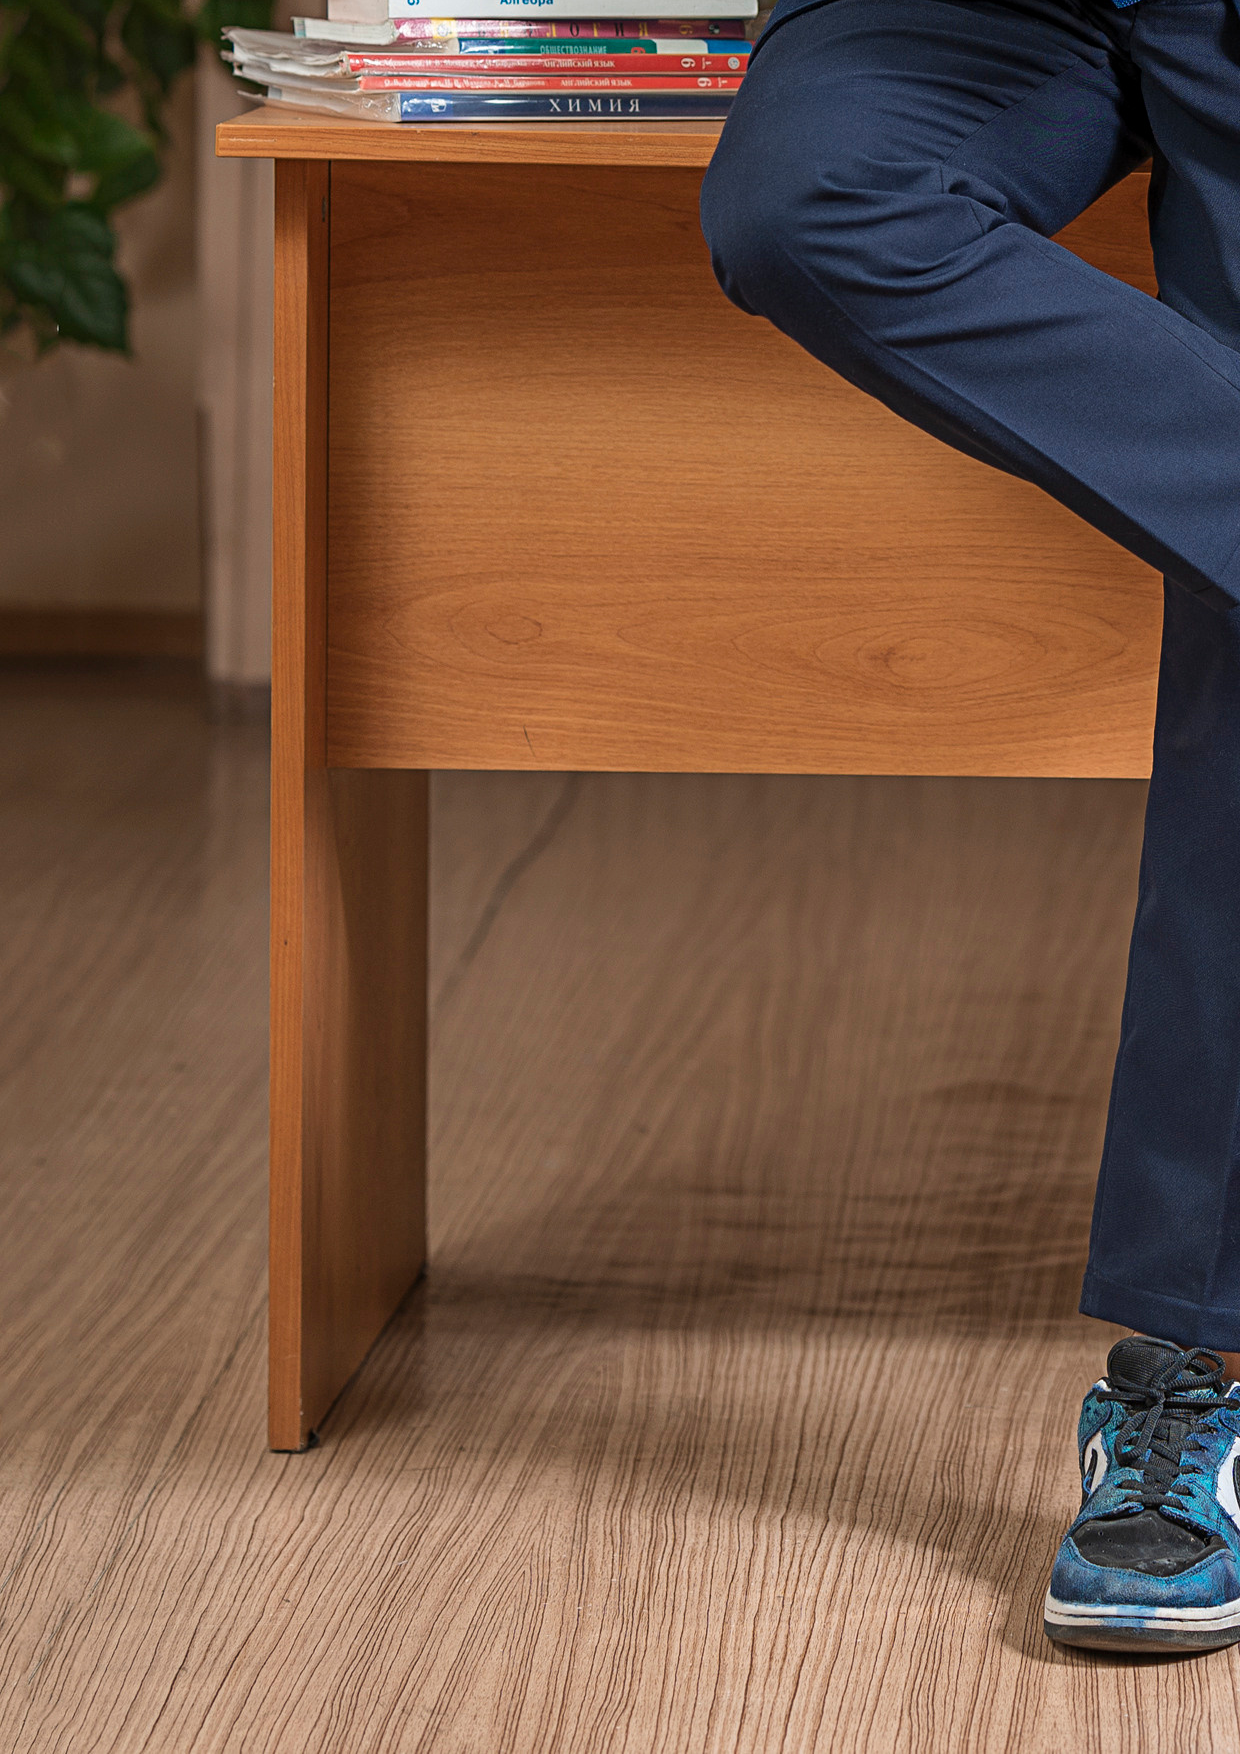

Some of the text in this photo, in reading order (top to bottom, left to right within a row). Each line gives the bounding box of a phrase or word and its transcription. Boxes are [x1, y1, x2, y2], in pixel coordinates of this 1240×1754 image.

[593, 59, 615, 68] ЯЗЫК
[560, 78, 610, 87] АНГЛИЙСКИЙ
[611, 79, 633, 87] ЯЗЫК
[549, 98, 640, 113] ХИМИЯ
